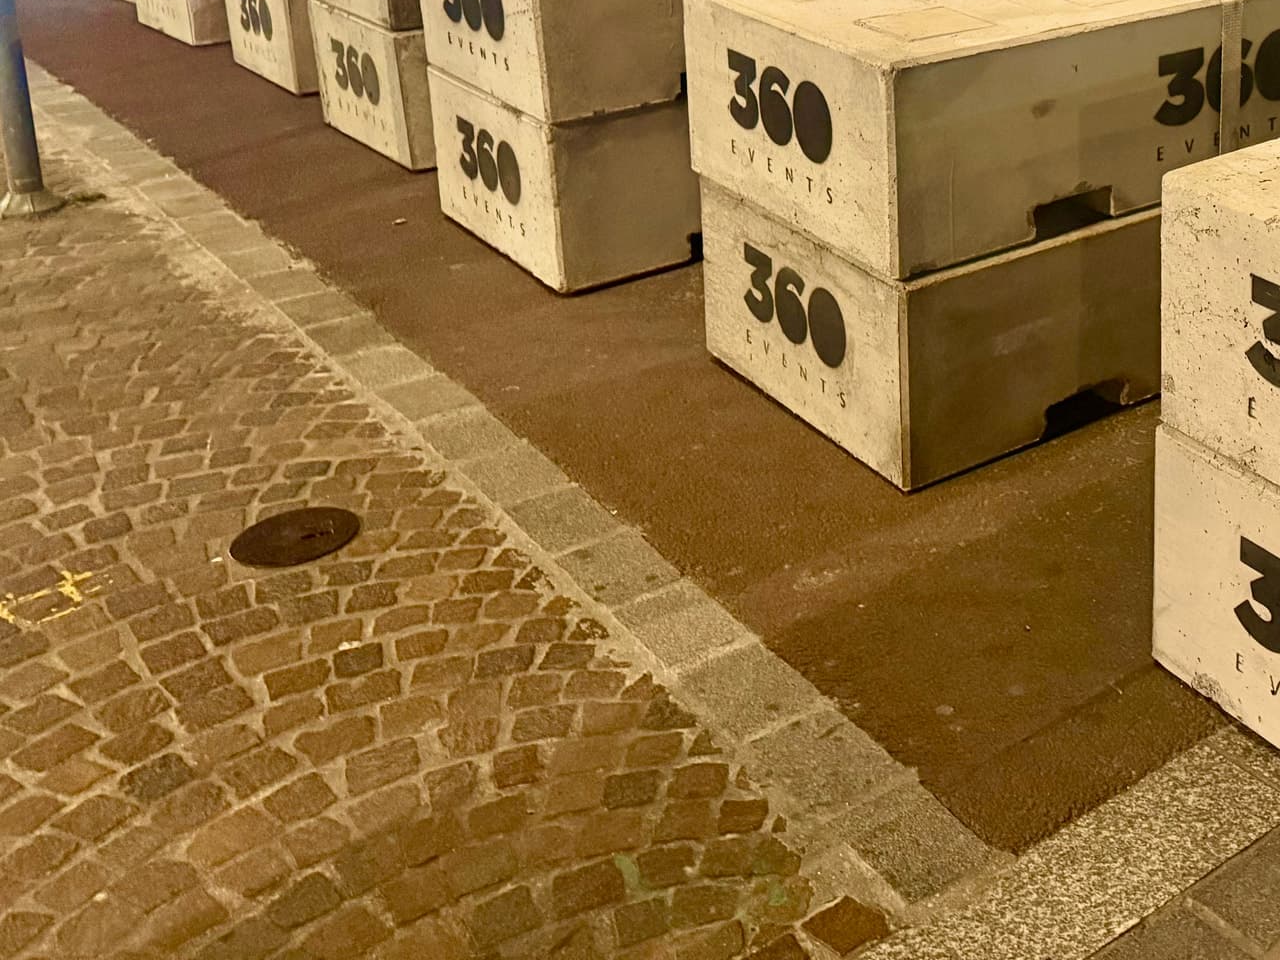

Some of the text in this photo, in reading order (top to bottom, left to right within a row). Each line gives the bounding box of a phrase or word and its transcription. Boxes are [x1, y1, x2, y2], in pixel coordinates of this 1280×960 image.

[331, 38, 380, 107] 360
[727, 47, 833, 164] 360
[456, 114, 521, 206] 360
[731, 139, 833, 204] EVENTS
[743, 241, 846, 369] 360
[746, 328, 846, 409] EVENTS
